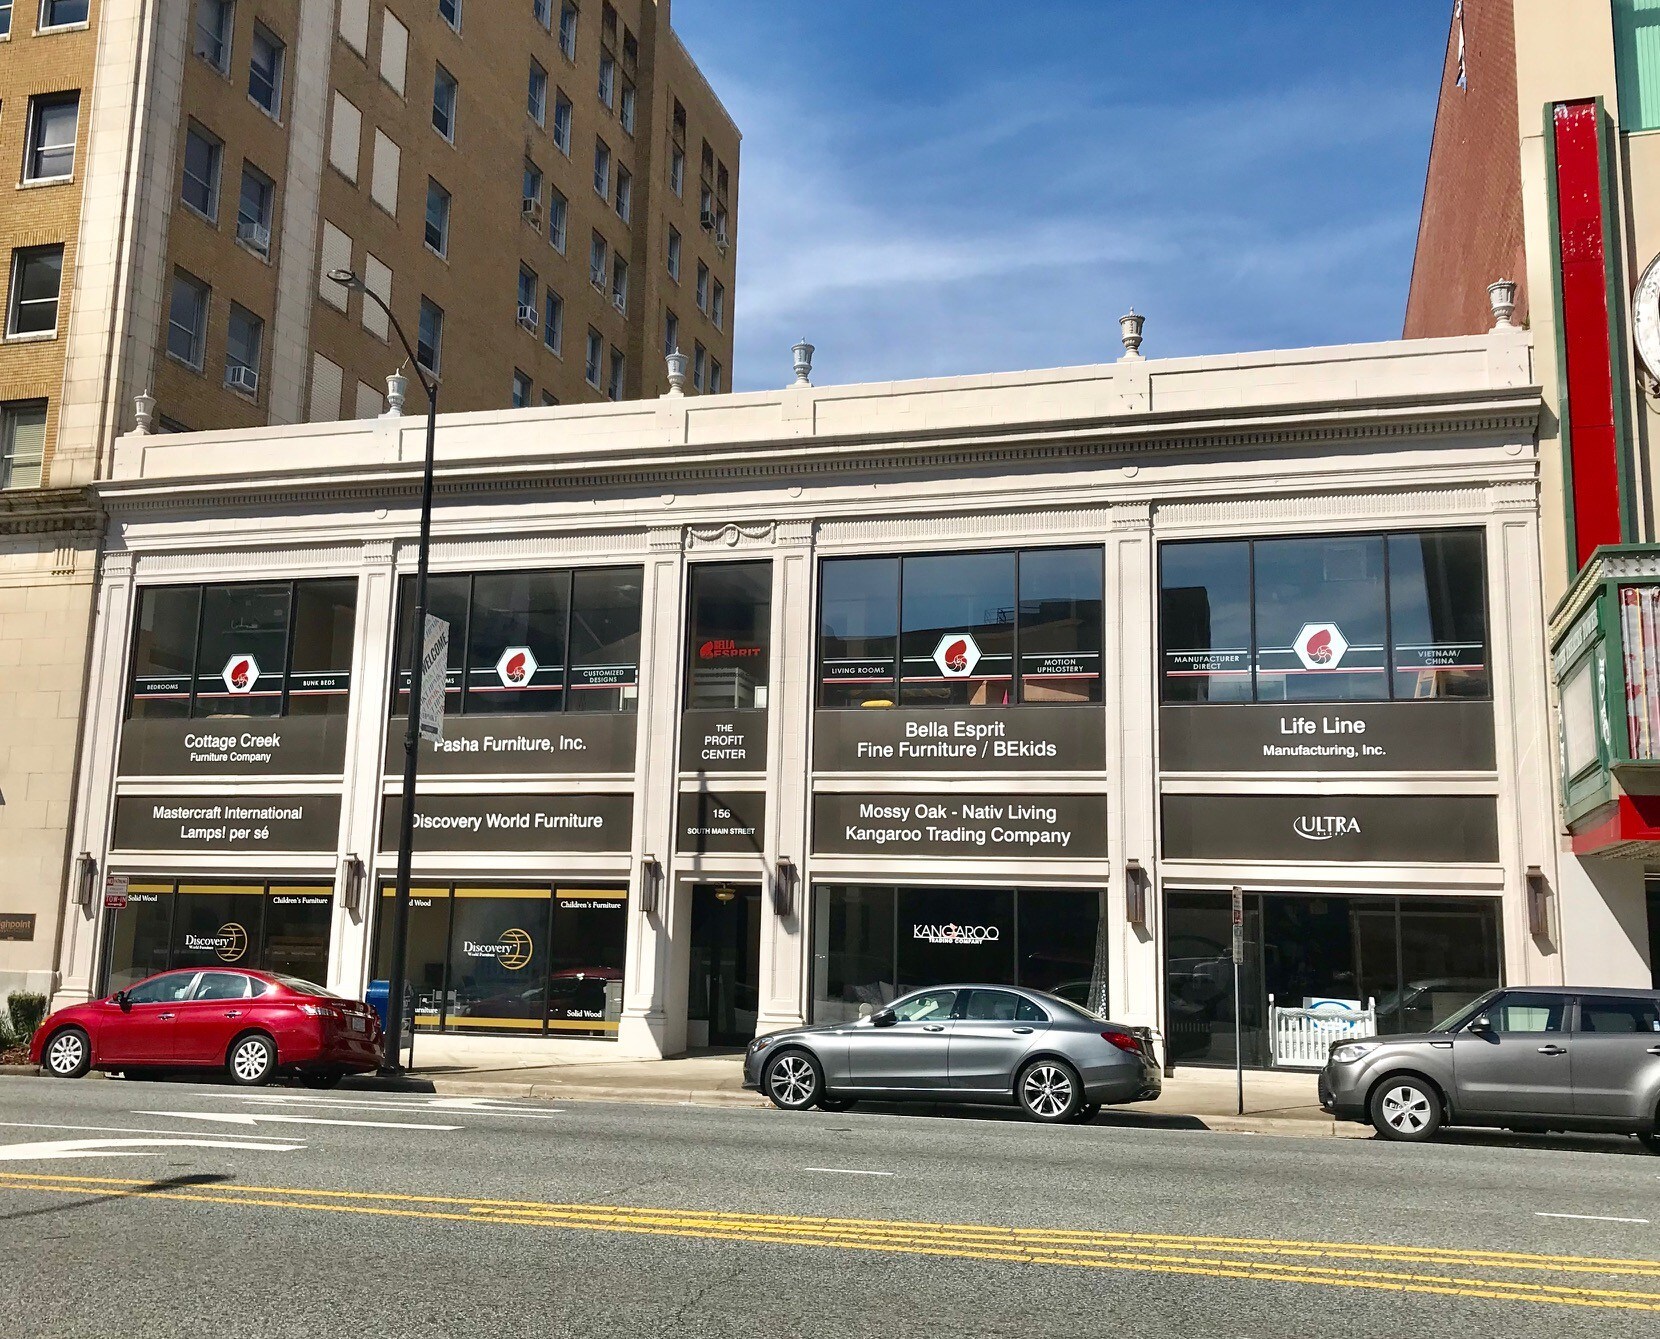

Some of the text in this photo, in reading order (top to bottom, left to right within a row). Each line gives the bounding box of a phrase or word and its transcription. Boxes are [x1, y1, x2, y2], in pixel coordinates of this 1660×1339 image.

[422, 632, 448, 675] WELCOME
[1173, 655, 1241, 664] MANUFACTURER
[1417, 649, 1461, 658] VIETNAM/
[1192, 662, 1222, 670] DIRECT
[1424, 657, 1455, 665] CHINA
[583, 669, 624, 677] CUSTOMIZED
[1036, 665, 1084, 673] UPHLOSTERY
[716, 724, 733, 732] THE
[906, 721, 1005, 740] Bella Esprit
[1281, 717, 1365, 734] Life Line
[184, 733, 280, 751] Cottage Creek
[434, 735, 586, 752] Pasha Furniture, Inc.
[705, 736, 744, 745] PROFIT
[702, 749, 745, 759] CENTER
[858, 741, 1056, 758] Fine Furniture / BEkids
[1264, 745, 1386, 758] Manufacturing, Inc.
[191, 752, 271, 763] Furniture Company
[153, 806, 302, 819] Mastercraft International
[713, 809, 730, 818] 156
[860, 804, 910, 821] Mossy
[915, 804, 947, 818] Oak
[963, 805, 1003, 819] Nativ
[1009, 805, 1056, 823] Living
[413, 813, 603, 831] Discovery World Furniture
[1301, 816, 1361, 832] ULTRA
[181, 826, 269, 842] Lamps! per sé
[846, 826, 1071, 846] Kangaroo Trading Company
[0, 920, 31, 929] ghpoint
[914, 924, 999, 939] KANGAROO
[185, 935, 229, 947] Discovery
[464, 941, 512, 955] Discovery
